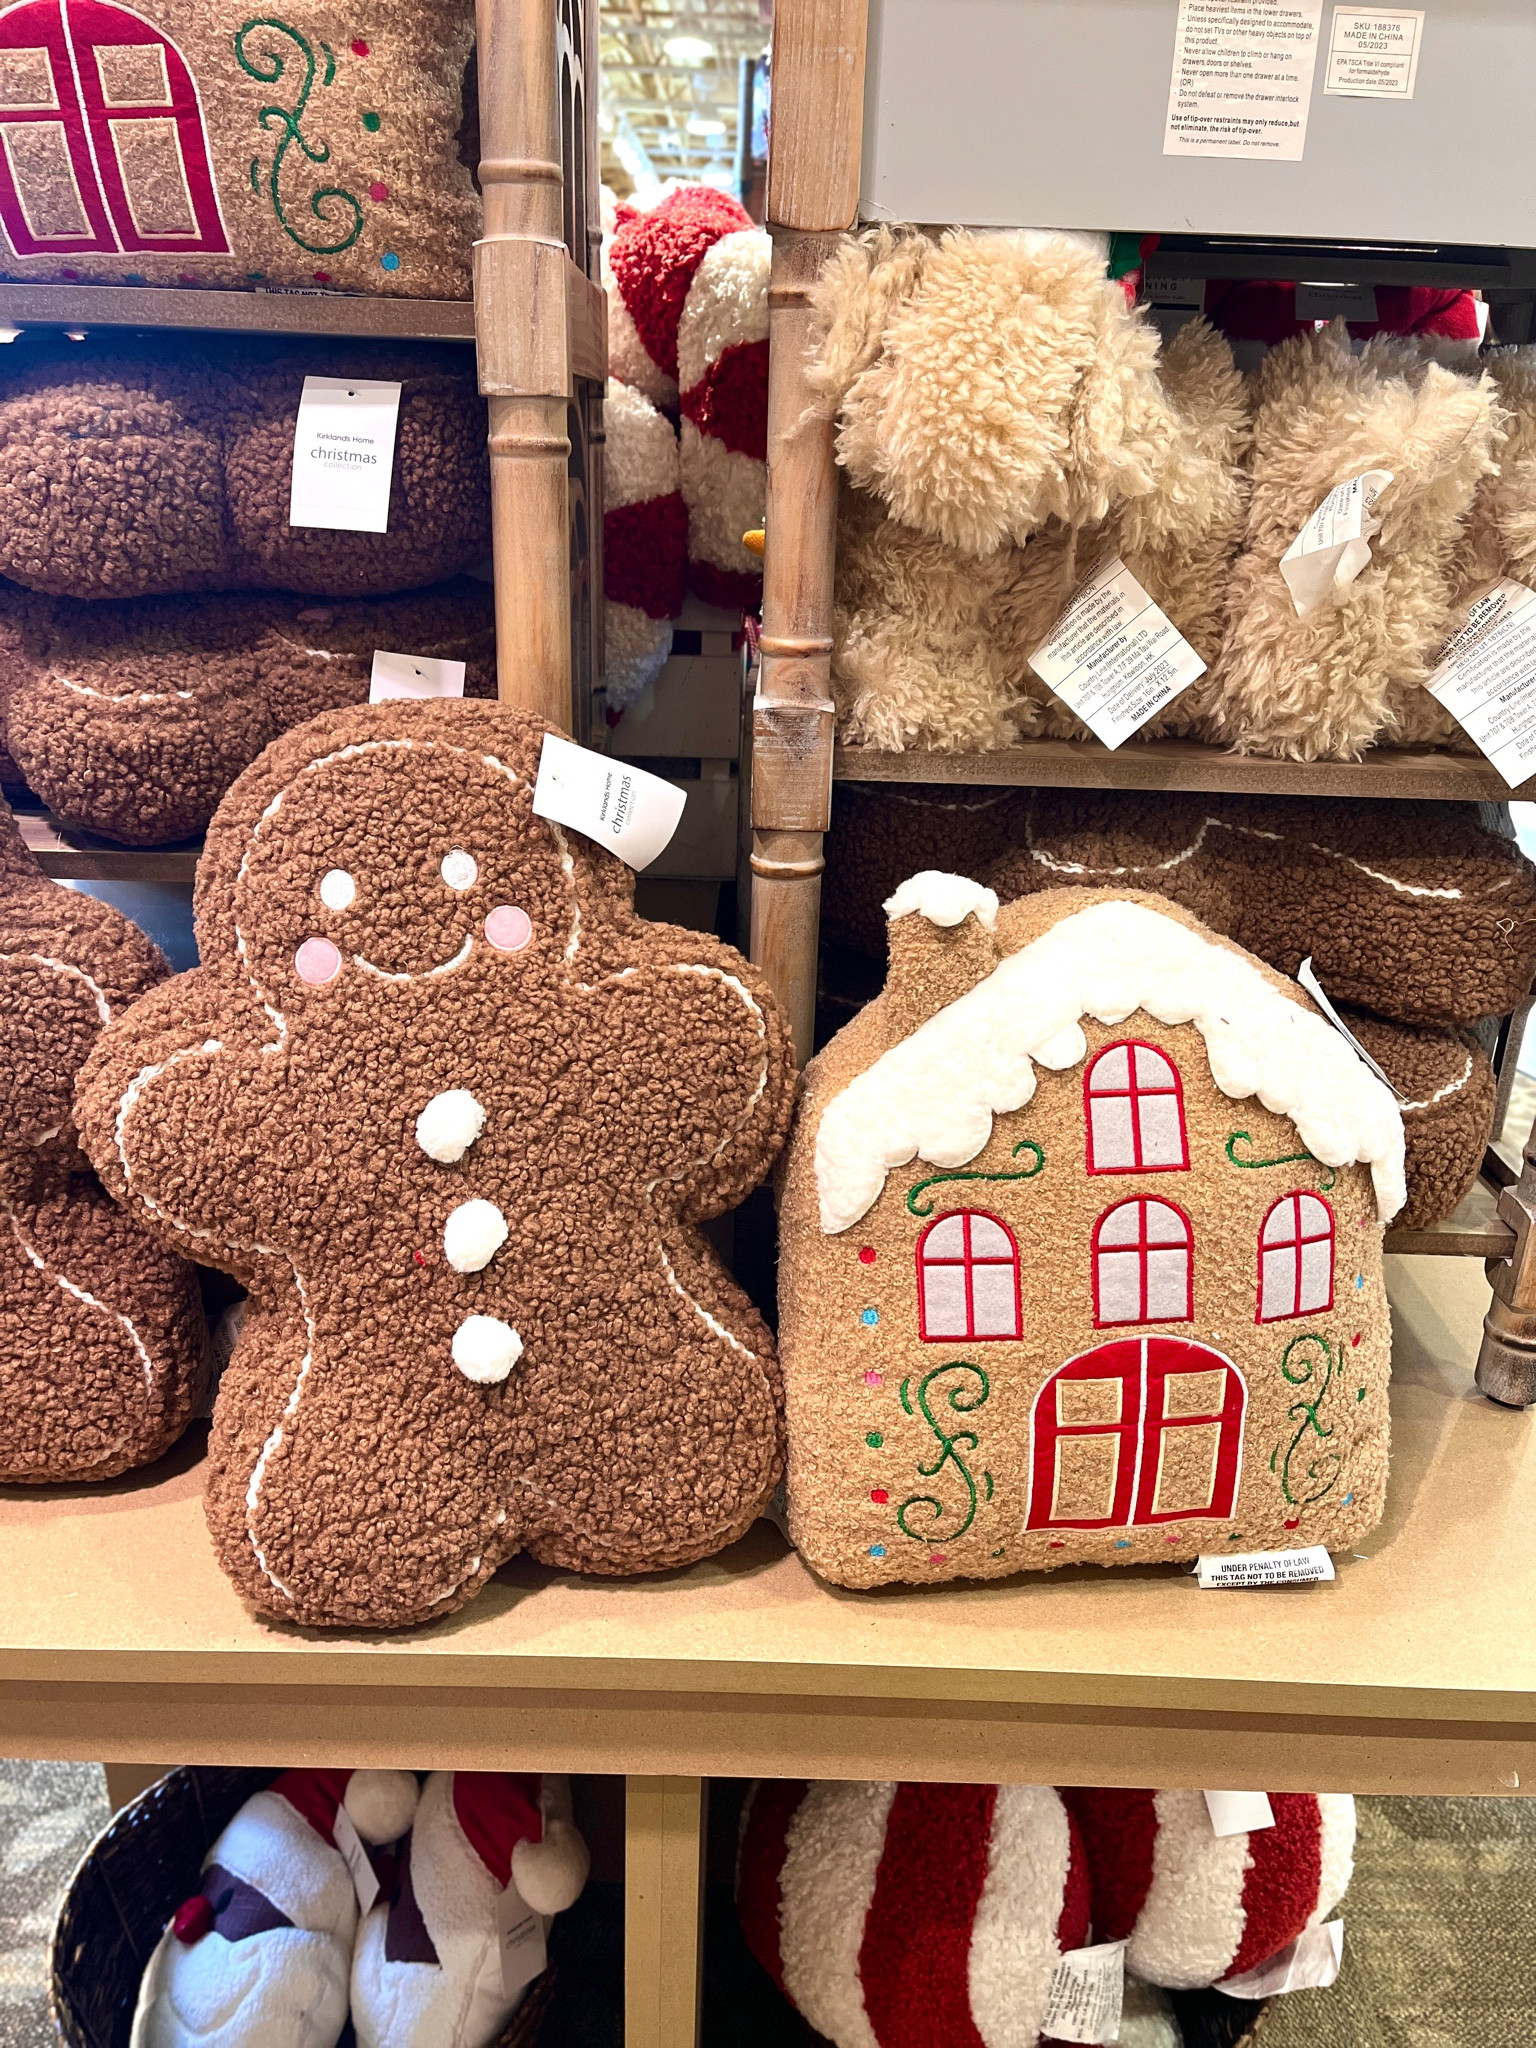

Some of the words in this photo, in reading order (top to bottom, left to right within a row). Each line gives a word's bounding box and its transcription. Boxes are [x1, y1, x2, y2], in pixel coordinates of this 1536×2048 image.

[1206, 5, 1230, 13] heaviest
[1263, 8, 1279, 16] lower
[1187, 15, 1207, 23] Unless
[1208, 17, 1239, 26] specifically
[1240, 19, 1266, 27] designed
[1374, 24, 1400, 32] 188376
[1249, 29, 1265, 38] heavy
[1266, 31, 1286, 39] objects
[1296, 32, 1304, 40] top
[1305, 32, 1312, 40] of
[1344, 31, 1367, 39] MADE
[1379, 33, 1403, 41] CHINA
[1358, 41, 1388, 49] 05/2023
[1217, 49, 1240, 57] children
[1270, 52, 1284, 61] hang
[1182, 68, 1198, 76] Never
[1254, 72, 1274, 80] drawer
[1338, 76, 1365, 84] Production
[1180, 78, 1194, 87] (OR)
[1179, 89, 1187, 97] Do
[1198, 90, 1216, 98] defeat
[1275, 95, 1299, 103] interlock
[1190, 115, 1213, 123] tip-over
[1255, 119, 1267, 127] only
[352, 436, 374, 444] Home
[310, 447, 377, 464] christmas
[324, 462, 362, 470] collection
[1080, 603, 1096, 617] made
[1093, 597, 1103, 605] by
[1101, 590, 1111, 599] the
[1468, 608, 1477, 617] OF
[1476, 597, 1491, 609] LAW
[1047, 630, 1079, 659] manufacturer
[1077, 621, 1089, 633] that
[1087, 615, 1098, 624] the
[1096, 596, 1120, 617] materials
[1070, 639, 1086, 654] article
[1085, 632, 1094, 641] are
[1093, 610, 1119, 634] described
[1453, 635, 1465, 648] NOT
[1464, 627, 1473, 636] TO
[1471, 619, 1481, 629] BE
[1136, 630, 1148, 642] LTD
[1075, 638, 1103, 664] accordance
[1102, 628, 1114, 640] with
[1087, 641, 1120, 670] Manufacturer
[1118, 635, 1127, 643] by
[1107, 703, 1120, 714] Date
[1144, 672, 1157, 683] July
[1154, 660, 1169, 675] 2023
[1500, 676, 1535, 703] Manufacturer
[1131, 705, 1149, 721] MADE
[1146, 700, 1154, 708] IN
[1152, 686, 1172, 702] CHINA
[614, 775, 629, 834] christmas
[1221, 1564, 1247, 1572] UNDER
[1249, 1561, 1281, 1571] PENALTY
[1283, 1559, 1292, 1567] OF
[1293, 1557, 1310, 1565] LAW
[1288, 1567, 1324, 1577] REMOVED
